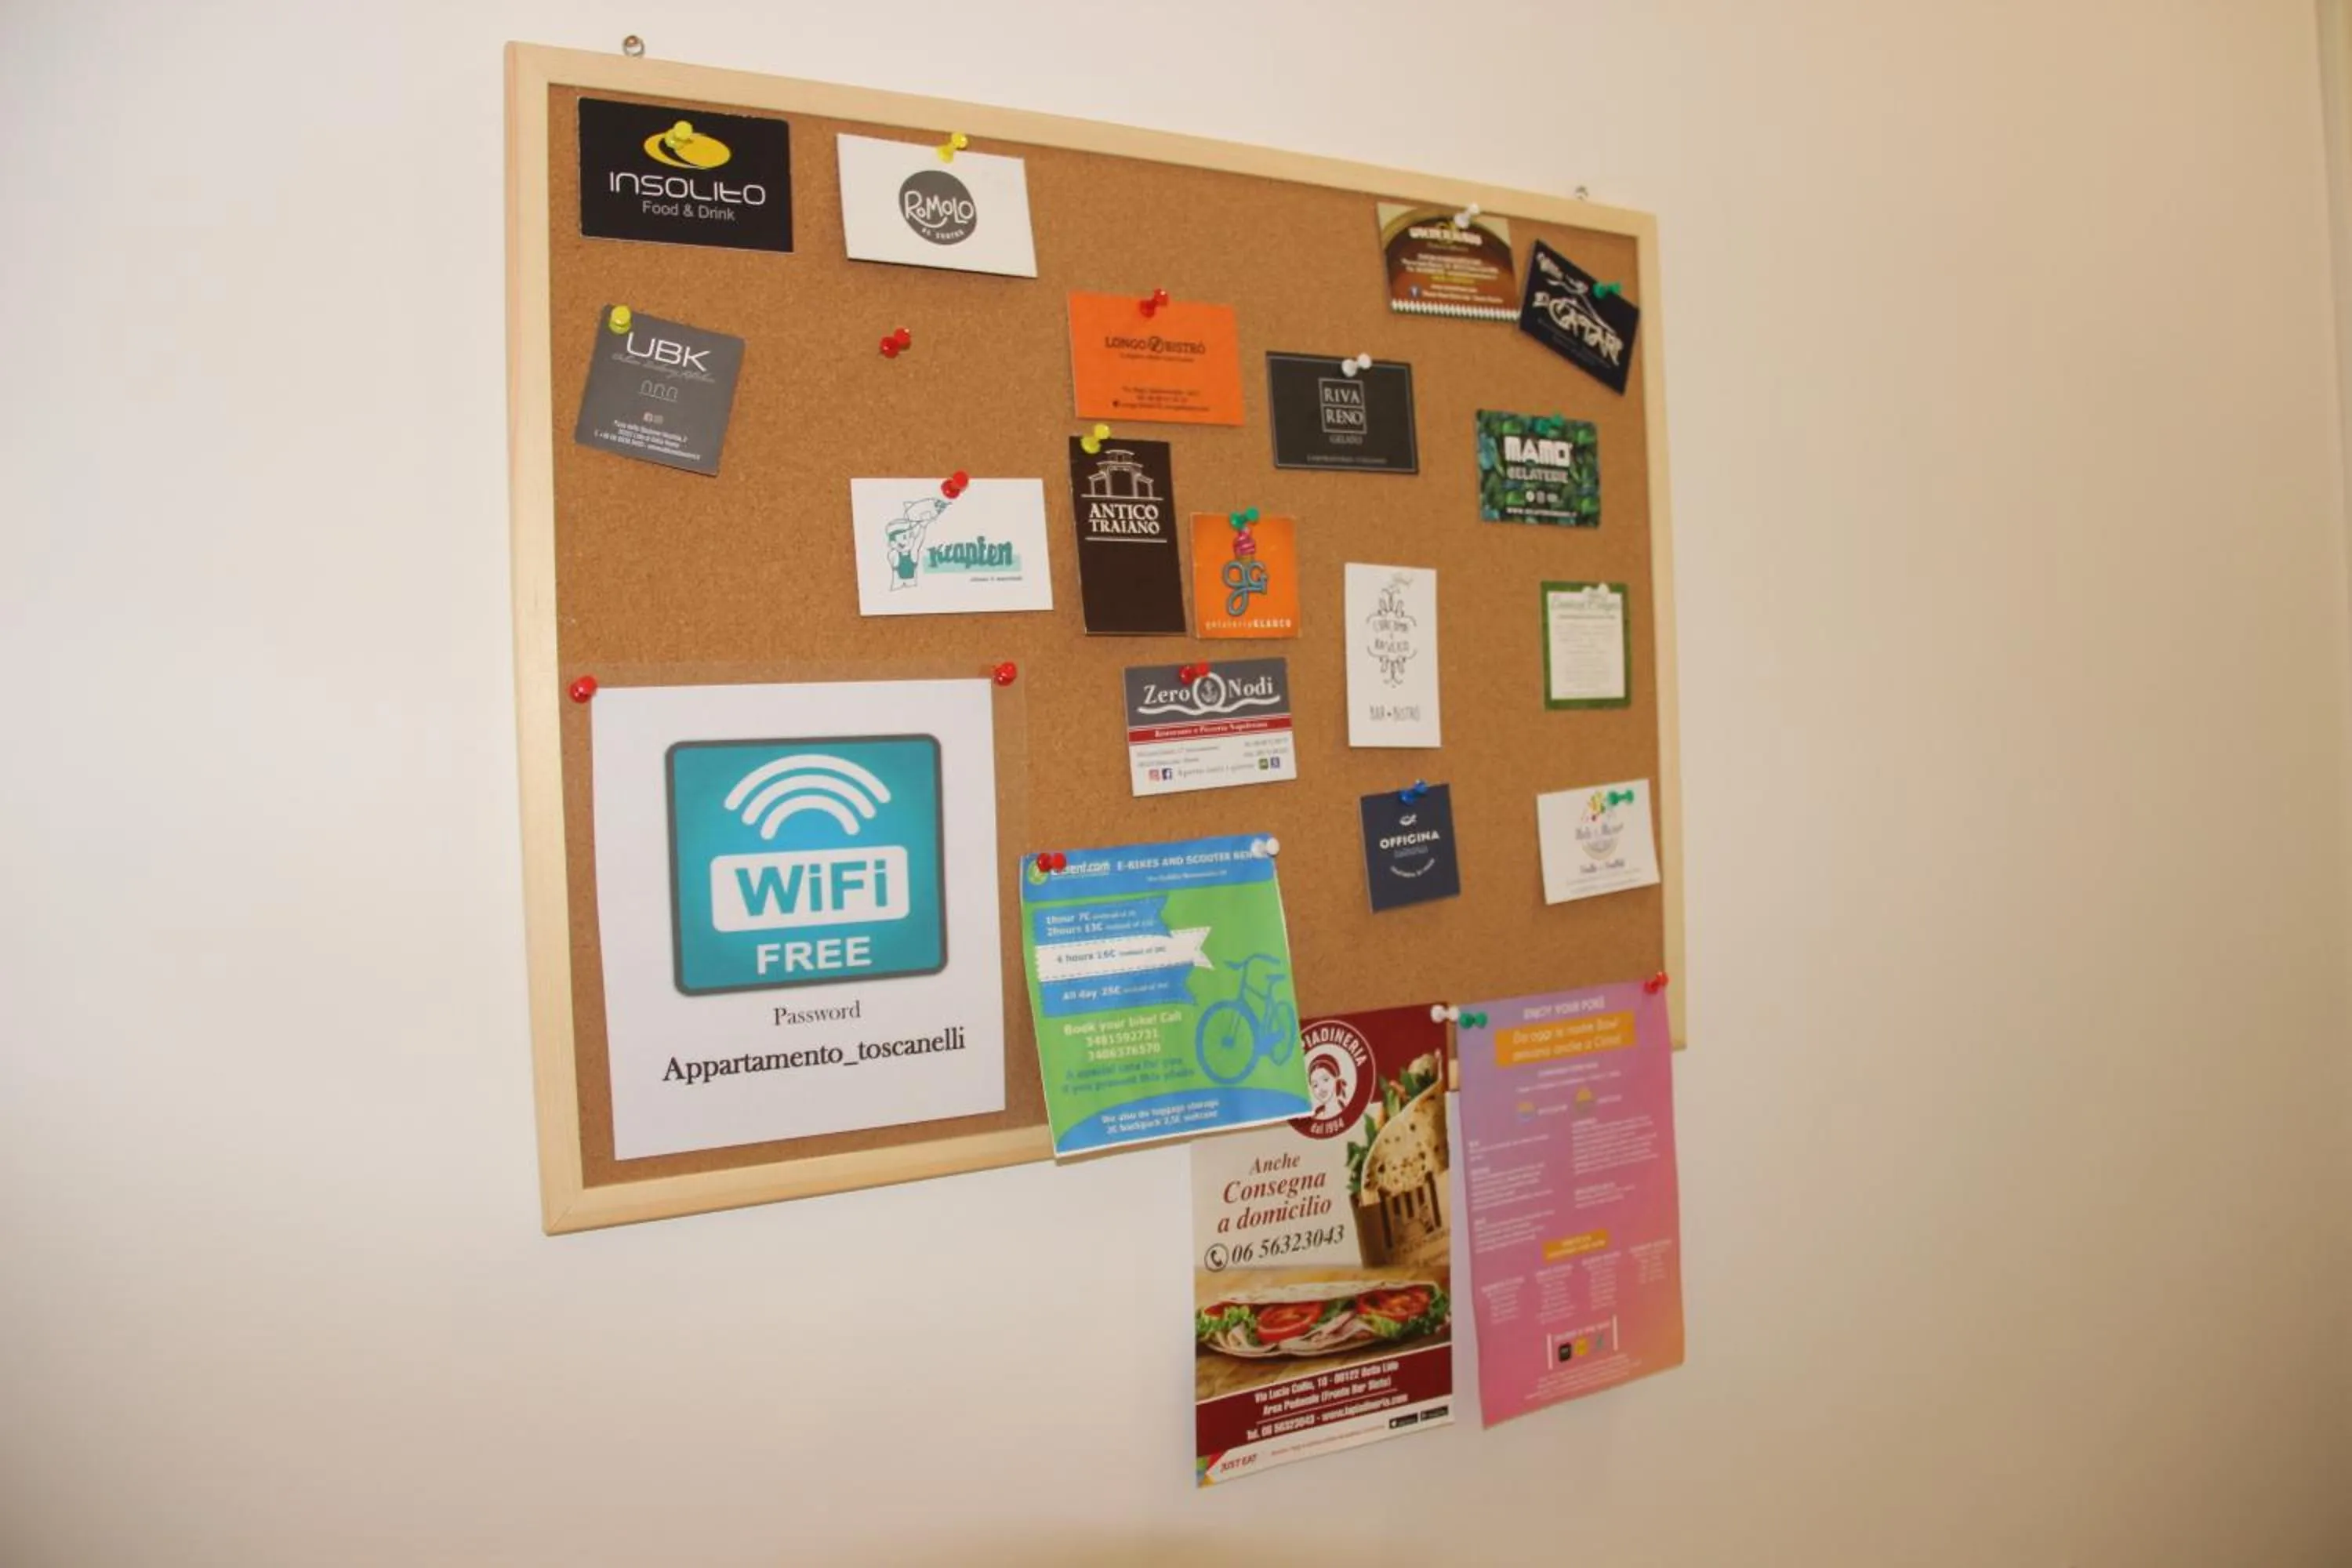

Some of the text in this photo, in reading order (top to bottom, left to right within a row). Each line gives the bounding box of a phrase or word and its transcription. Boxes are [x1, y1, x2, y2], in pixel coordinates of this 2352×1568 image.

[642, 200, 736, 221] Food & Drink
[627, 332, 710, 372] UBK
[1324, 387, 1360, 404] RIVA
[1326, 408, 1363, 425] RENO
[1089, 503, 1159, 521] ANTICO
[1089, 519, 1160, 535] TRAIANO
[1143, 677, 1273, 705] Zero Nodi
[1380, 830, 1440, 850] OFFICINA
[1163, 856, 1183, 866] AND
[1185, 852, 1230, 865] SCOOTER
[735, 859, 888, 917] WiFi
[757, 936, 872, 975] FREE
[1065, 953, 1093, 963] hours
[773, 1000, 861, 1026] Password
[1063, 1022, 1096, 1035] Book
[1100, 1020, 1126, 1032] your
[662, 1026, 966, 1085] Appartamento_toscanelli
[1250, 1152, 1301, 1175] Anche
[1223, 1172, 1327, 1204] Consegna
[1218, 1195, 1332, 1234] a domicilio
[1232, 1224, 1345, 1265] 06 56323043
[1254, 1392, 1268, 1404] Via
[1382, 1360, 1399, 1374] Lido
[1262, 1403, 1283, 1417] Area
[1351, 1382, 1367, 1395] Bar
[1247, 1428, 1261, 1442] Tel.
[1220, 1454, 1259, 1474] JUST EAT
